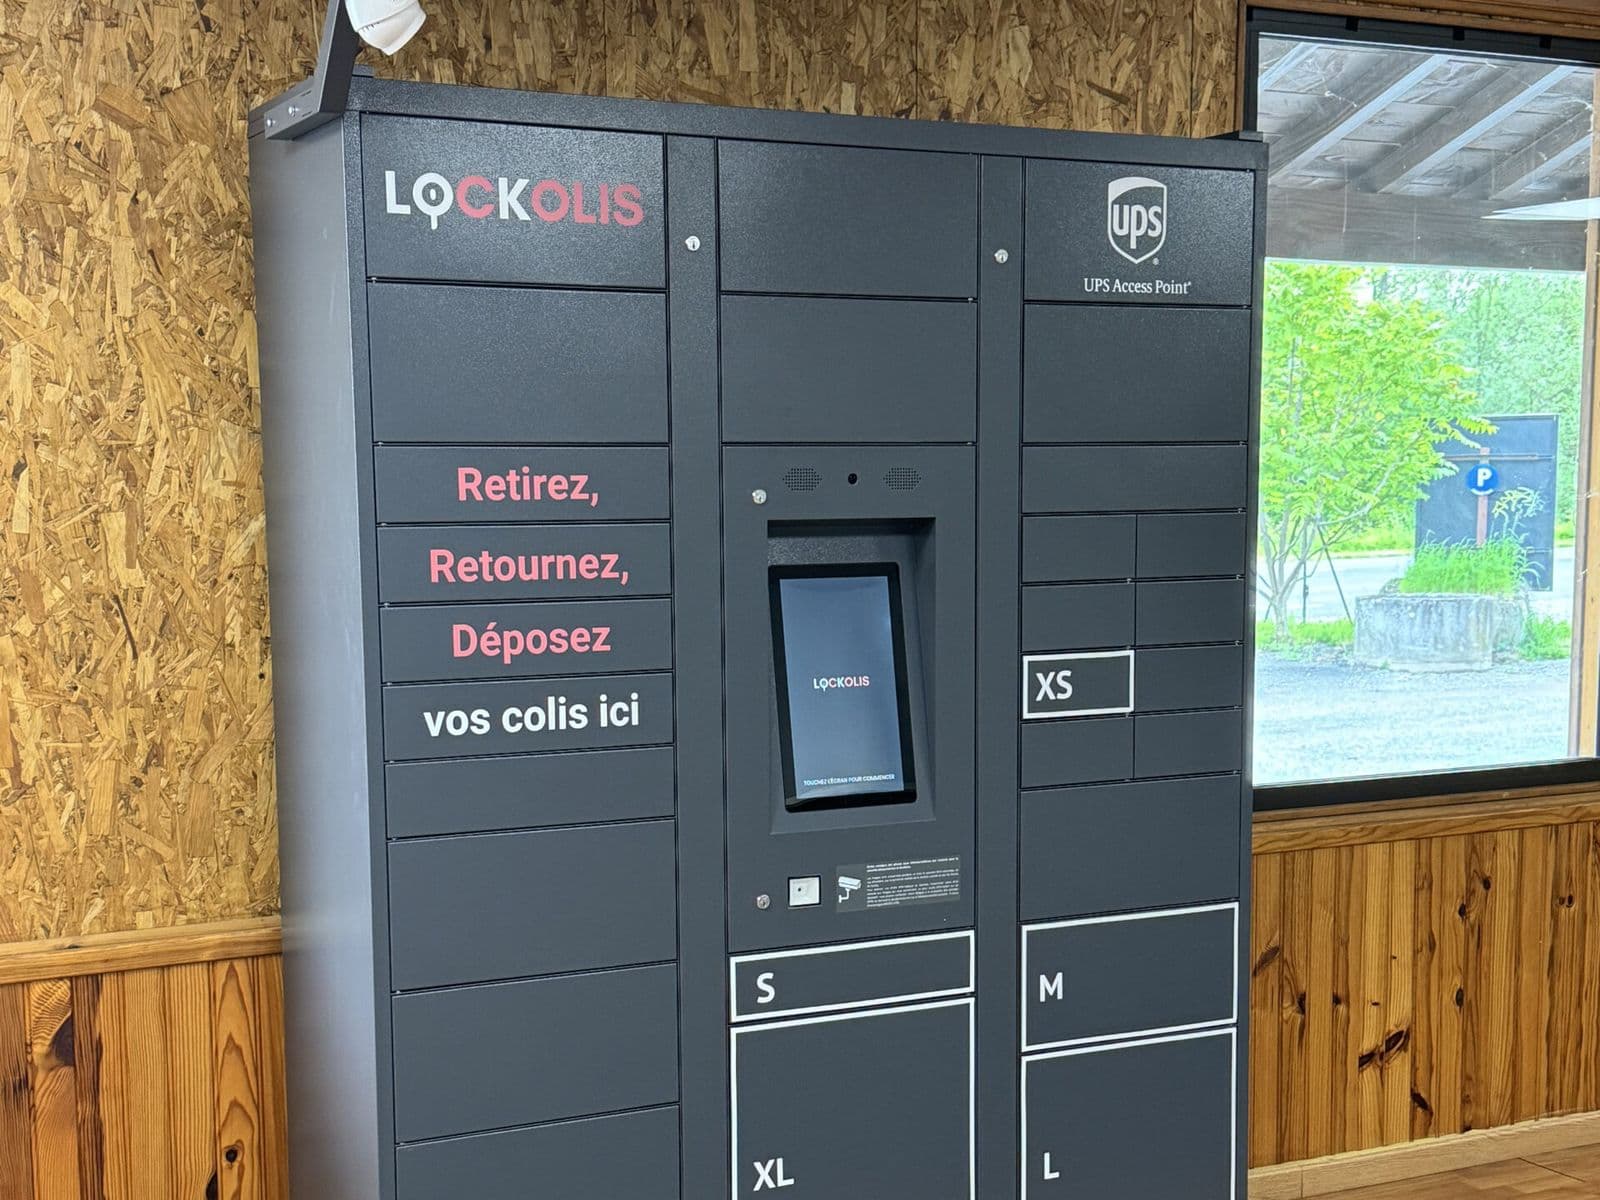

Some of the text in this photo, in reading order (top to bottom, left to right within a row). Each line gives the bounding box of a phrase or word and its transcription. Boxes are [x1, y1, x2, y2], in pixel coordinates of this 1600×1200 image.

[384, 169, 645, 230] LOCKOLIS
[1083, 278, 1110, 292] UPS
[1112, 279, 1153, 294] Access
[457, 466, 599, 508] Retirez,
[1477, 468, 1492, 487] P
[429, 549, 629, 586] Retournez,
[451, 622, 612, 665] Déposez
[813, 675, 870, 692] LOCKOLIS
[1035, 670, 1073, 701] XS
[423, 692, 640, 738] vos colis ici
[756, 972, 776, 1004] S
[1039, 971, 1064, 1003] M
[752, 1158, 795, 1192] XL
[1043, 1151, 1060, 1180] L
